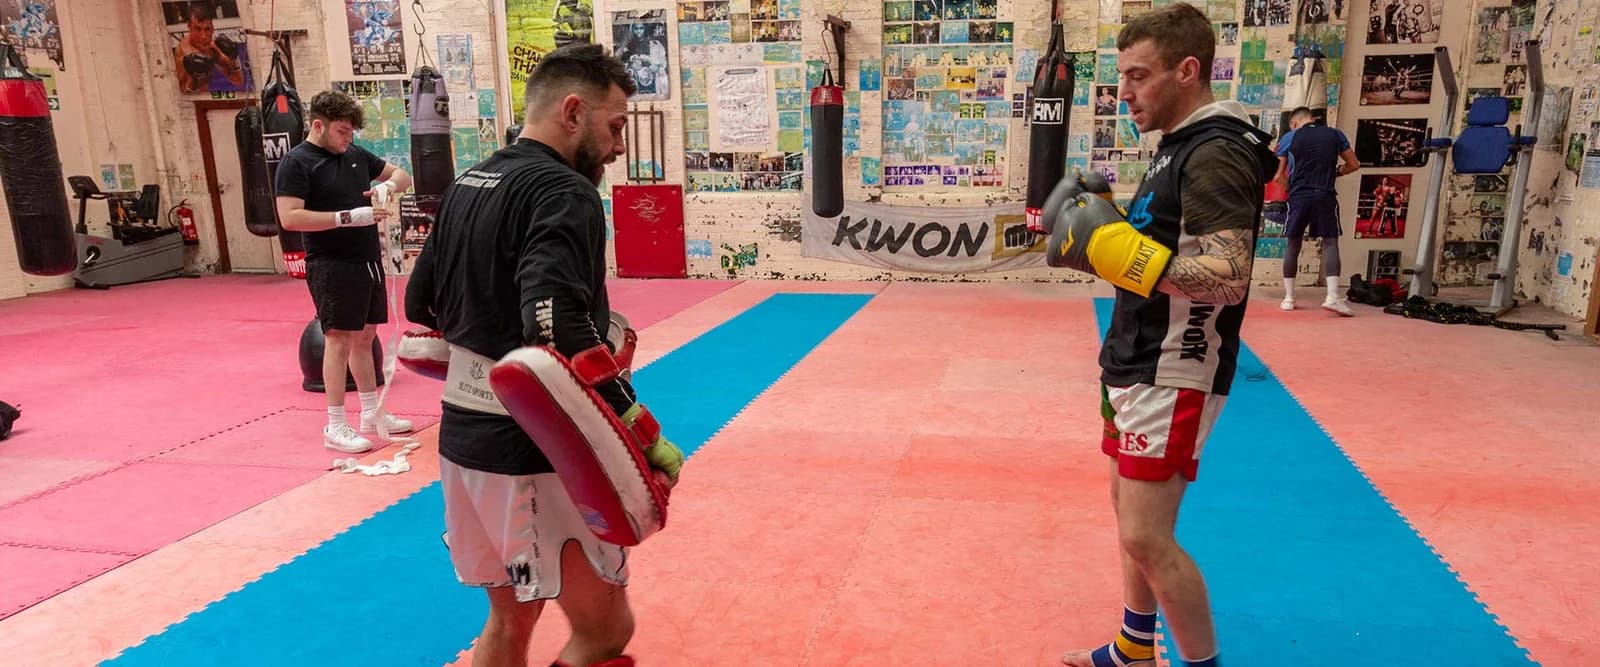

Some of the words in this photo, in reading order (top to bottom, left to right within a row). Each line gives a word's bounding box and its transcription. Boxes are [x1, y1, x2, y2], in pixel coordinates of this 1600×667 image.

[832, 216, 989, 258] KWON
[1123, 241, 1158, 285] EVERLAST
[1180, 300, 1215, 363] WORK
[1120, 432, 1148, 452] ES
